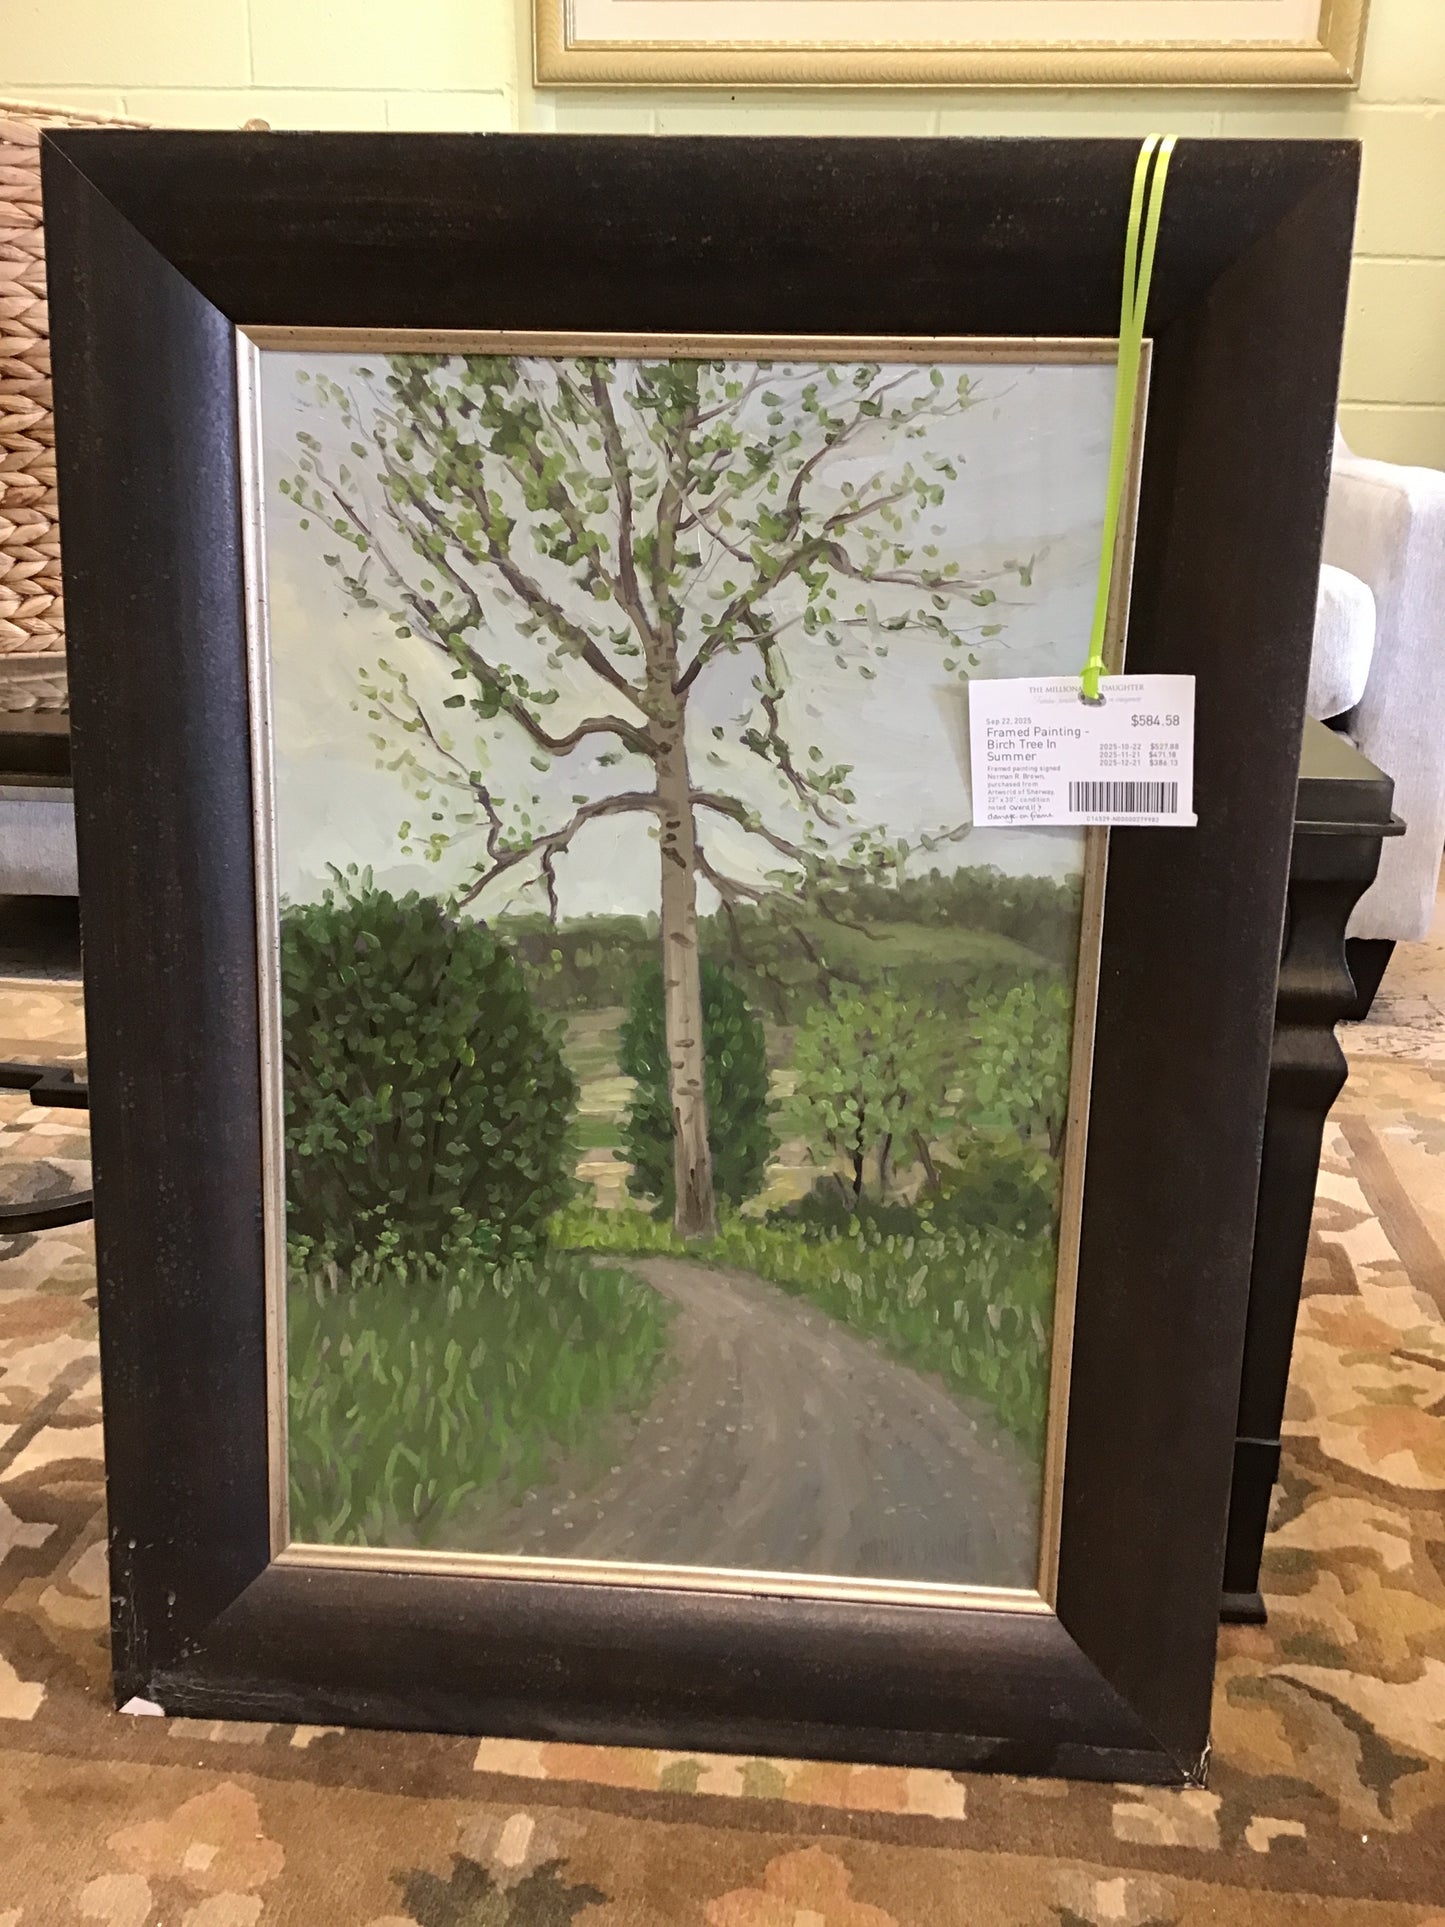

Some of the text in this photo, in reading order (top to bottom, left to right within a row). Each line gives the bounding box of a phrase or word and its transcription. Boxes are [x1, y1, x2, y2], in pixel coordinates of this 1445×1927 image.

[1101, 684, 1144, 692] DAUGHTER
[986, 718, 1000, 726] Sep
[1014, 717, 1032, 725] 2025
[1131, 714, 1180, 727] $584.58
[986, 726, 1030, 737] Framed
[1033, 726, 1081, 739] Painting
[987, 739, 1057, 750] Birch Tree In
[987, 751, 1037, 762] Summer
[1099, 759, 1141, 767] 2025-12-21
[1012, 765, 1038, 773] painting
[1039, 765, 1061, 773] signed
